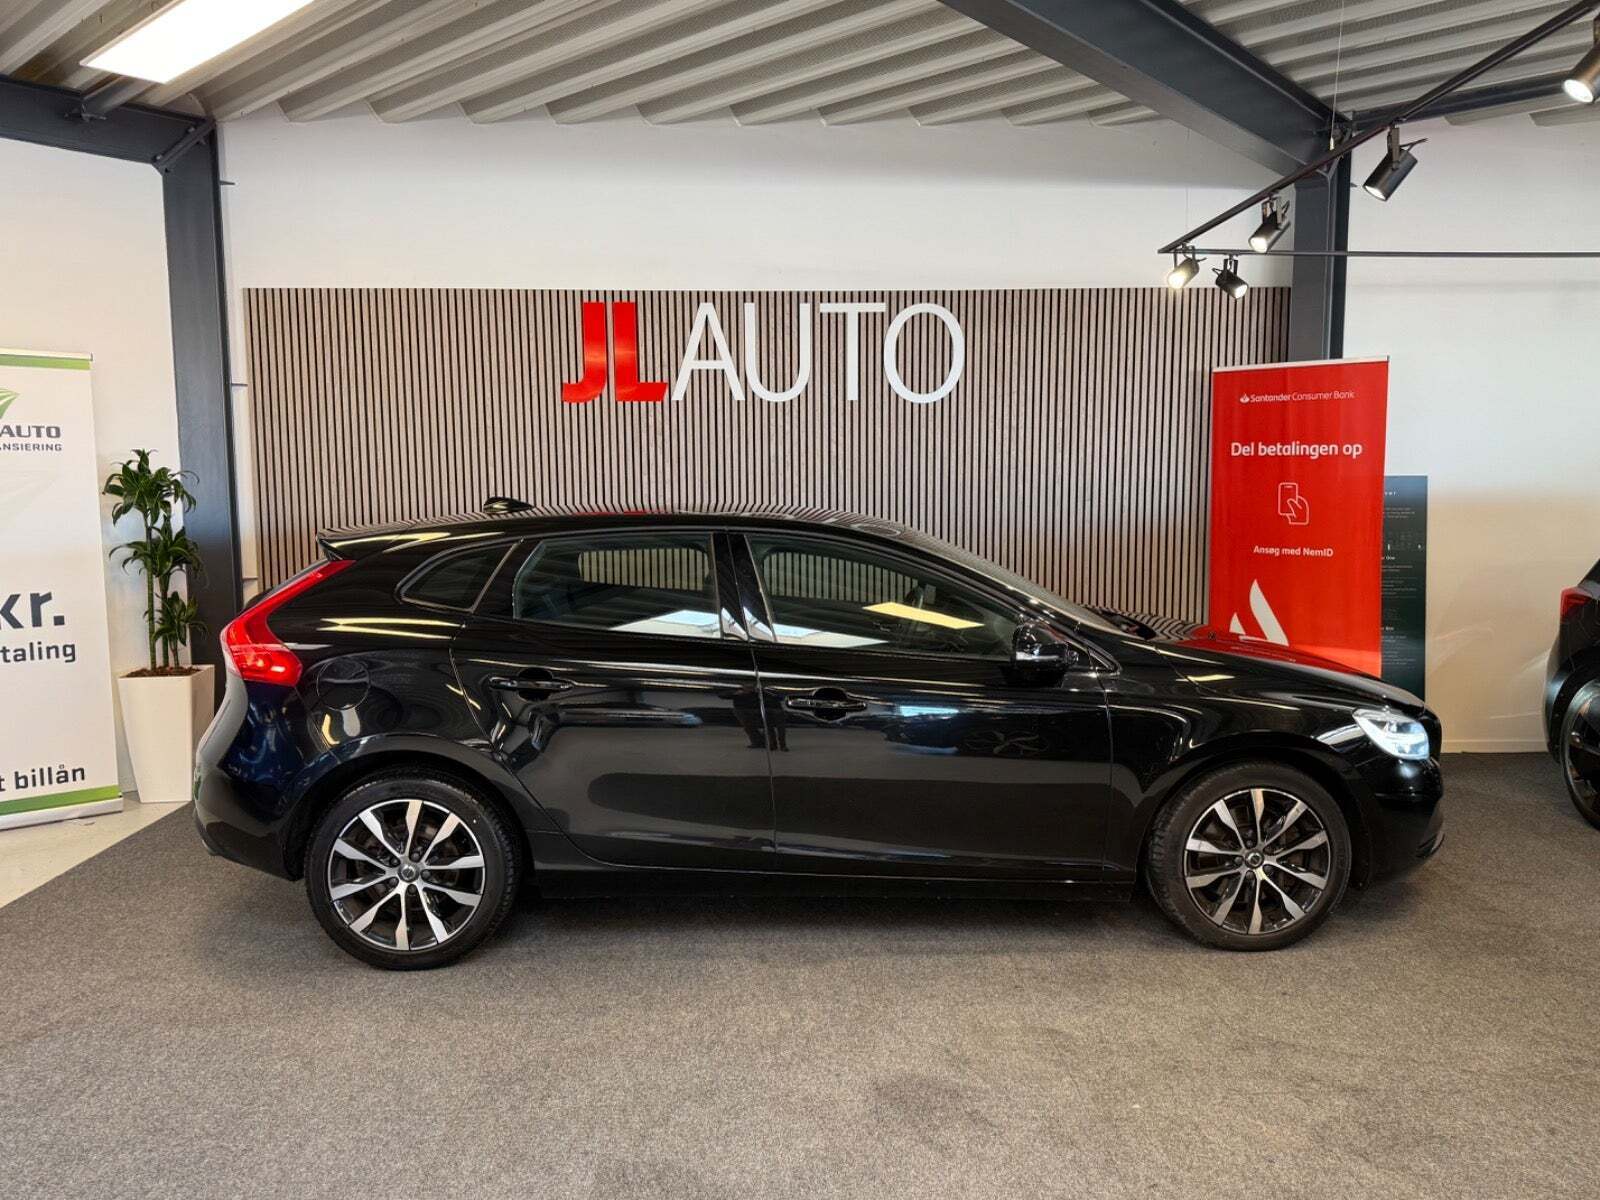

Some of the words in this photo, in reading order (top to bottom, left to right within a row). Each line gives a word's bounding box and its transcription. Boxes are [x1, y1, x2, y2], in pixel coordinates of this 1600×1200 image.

[671, 302, 966, 404] AUTO
[1250, 394, 1291, 403] Santander
[1292, 391, 1332, 401] Consumer
[1333, 390, 1355, 399] Bank
[0, 425, 61, 438] AUTO
[0, 443, 62, 452] NSIERING
[1231, 442, 1255, 456] Del
[1258, 441, 1339, 460] betalingen
[1342, 444, 1363, 459] op
[1253, 545, 1280, 557] Ansøg
[1281, 547, 1301, 556] med
[1302, 547, 1334, 557] NemID
[14, 764, 85, 790] billån
